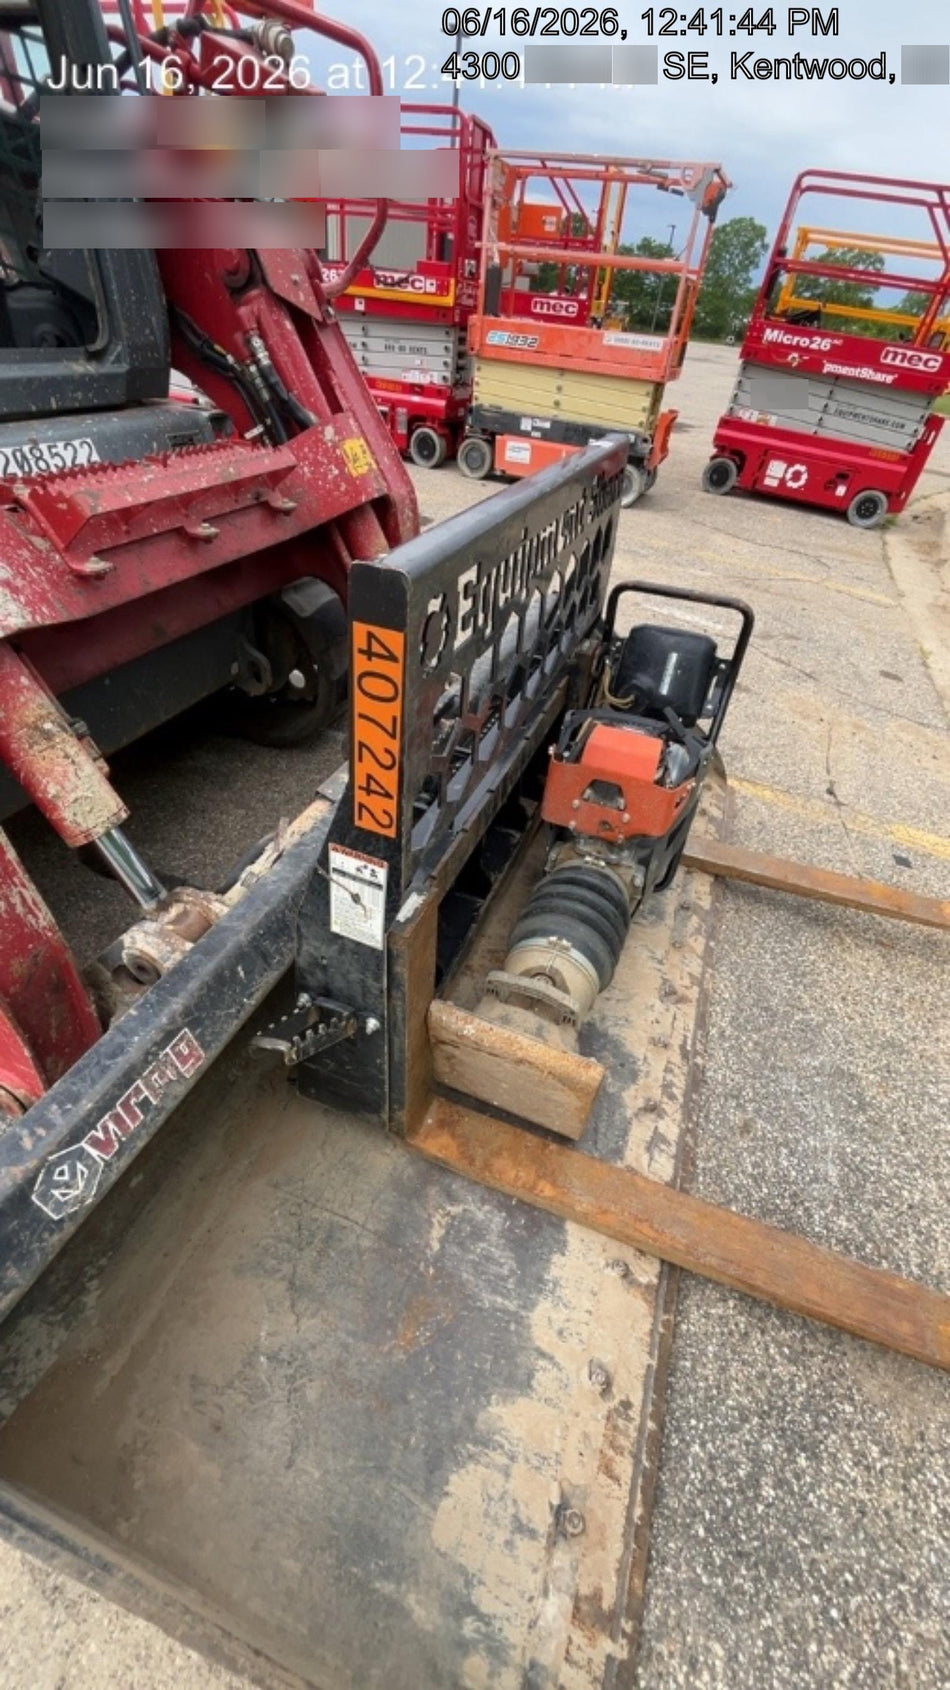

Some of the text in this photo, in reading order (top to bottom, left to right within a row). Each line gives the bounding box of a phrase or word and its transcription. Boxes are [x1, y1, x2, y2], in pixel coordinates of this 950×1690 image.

[532, 300, 577, 315] mec
[882, 349, 940, 370] mec
[357, 630, 400, 831] 407242
